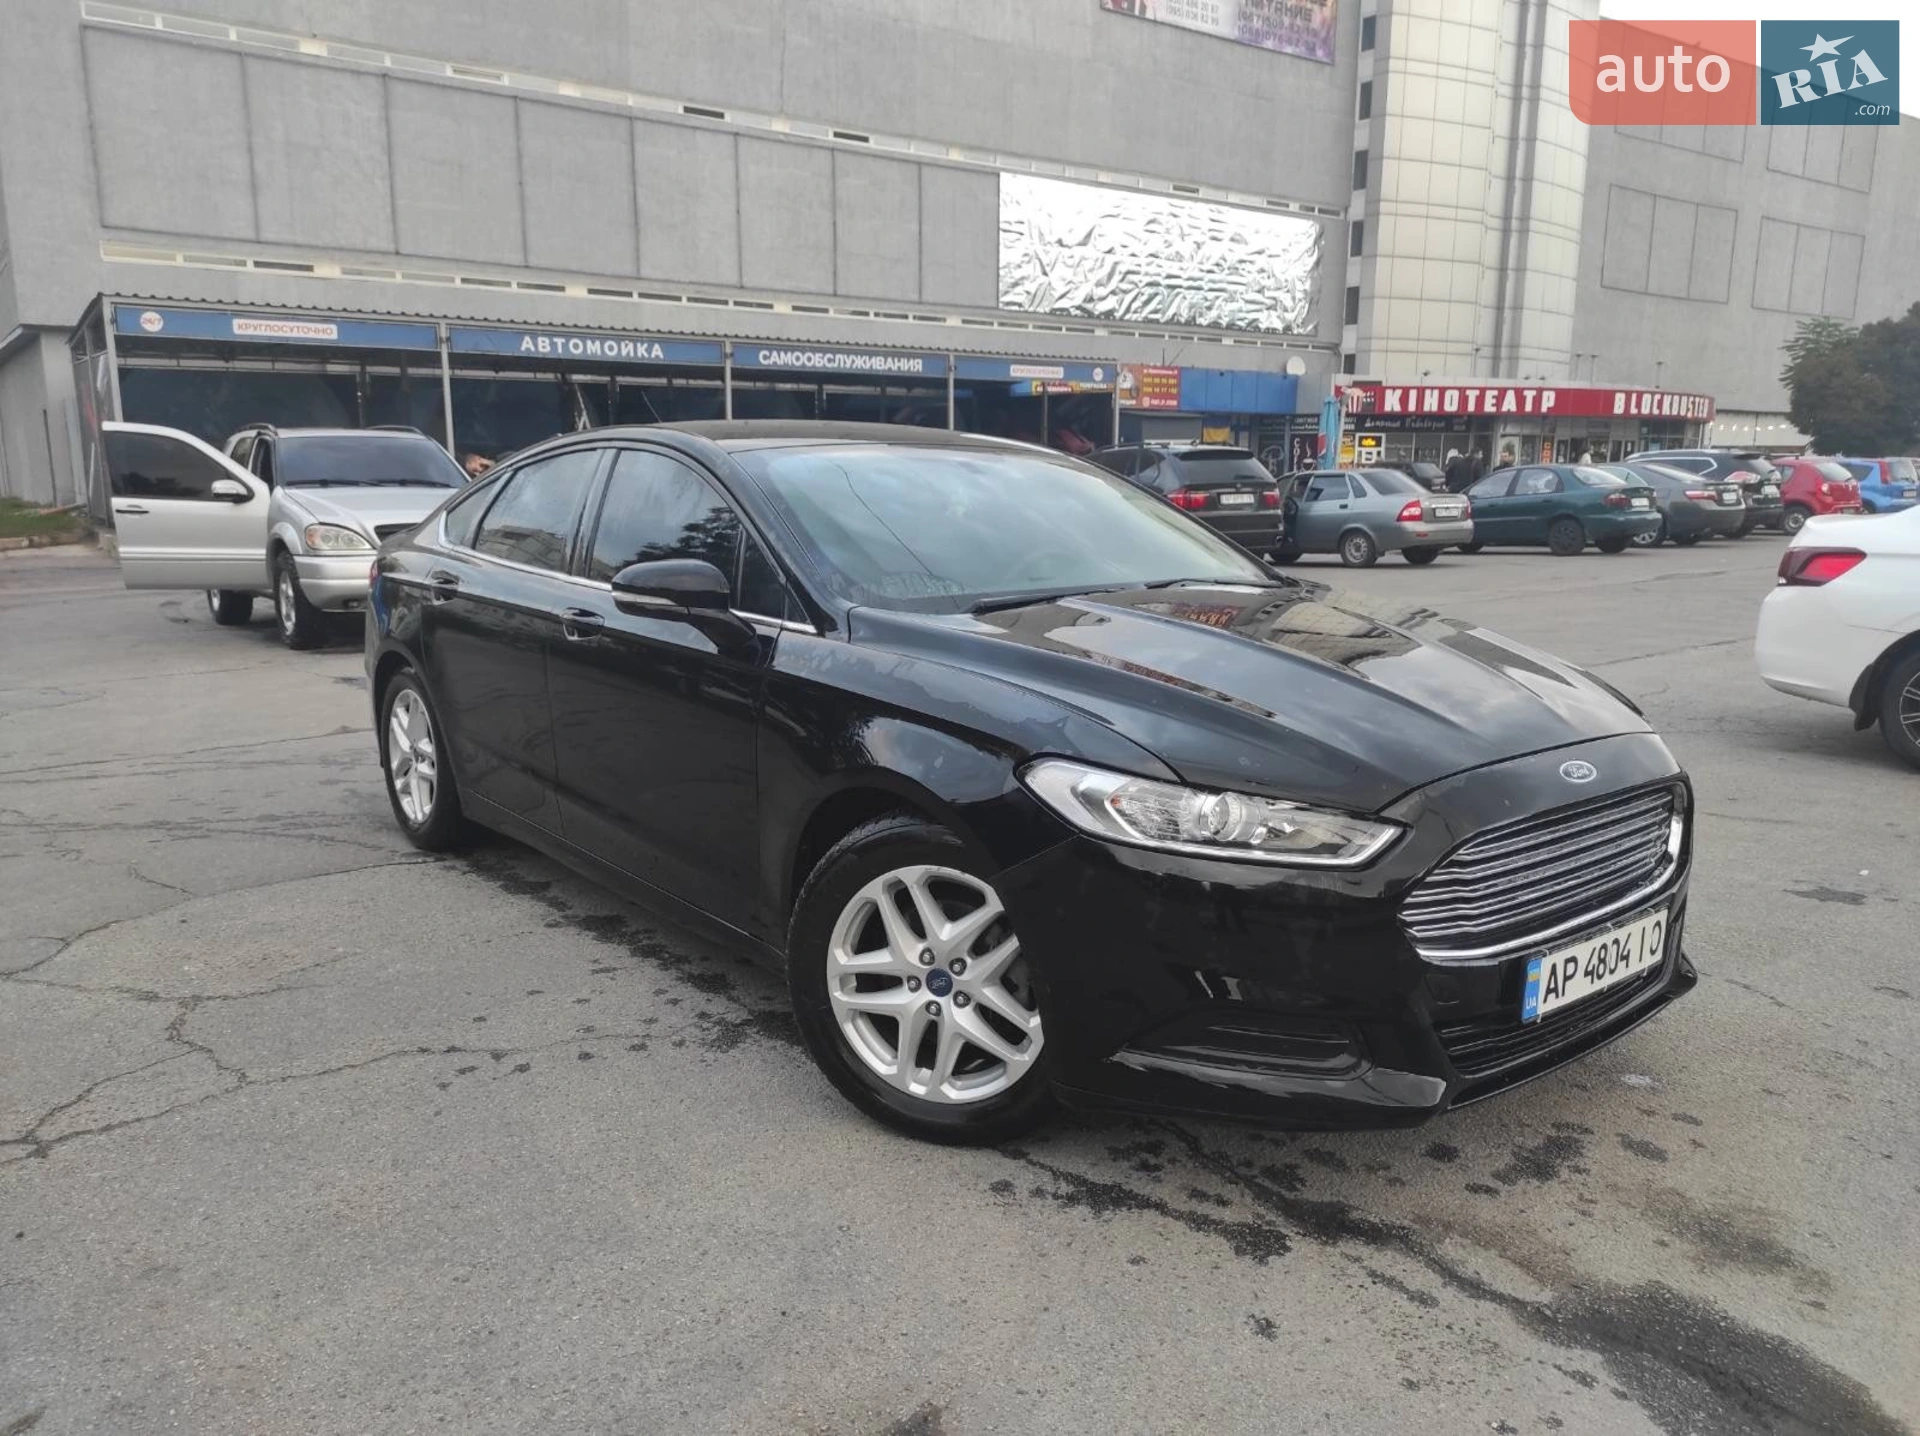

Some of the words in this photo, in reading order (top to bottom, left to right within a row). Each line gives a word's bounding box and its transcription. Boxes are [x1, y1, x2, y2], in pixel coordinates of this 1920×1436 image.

[237, 321, 335, 338] КРУГЛОСУТОЧНО
[520, 335, 665, 360] АВТОМОЙКА
[758, 349, 923, 373] САМООБСЛУЖИВАНИЯ
[1384, 387, 1556, 413] КІНОТЕАТР
[1543, 955, 1579, 1004] AP
[1583, 931, 1632, 985] 4804
[1525, 997, 1537, 1010] UA
